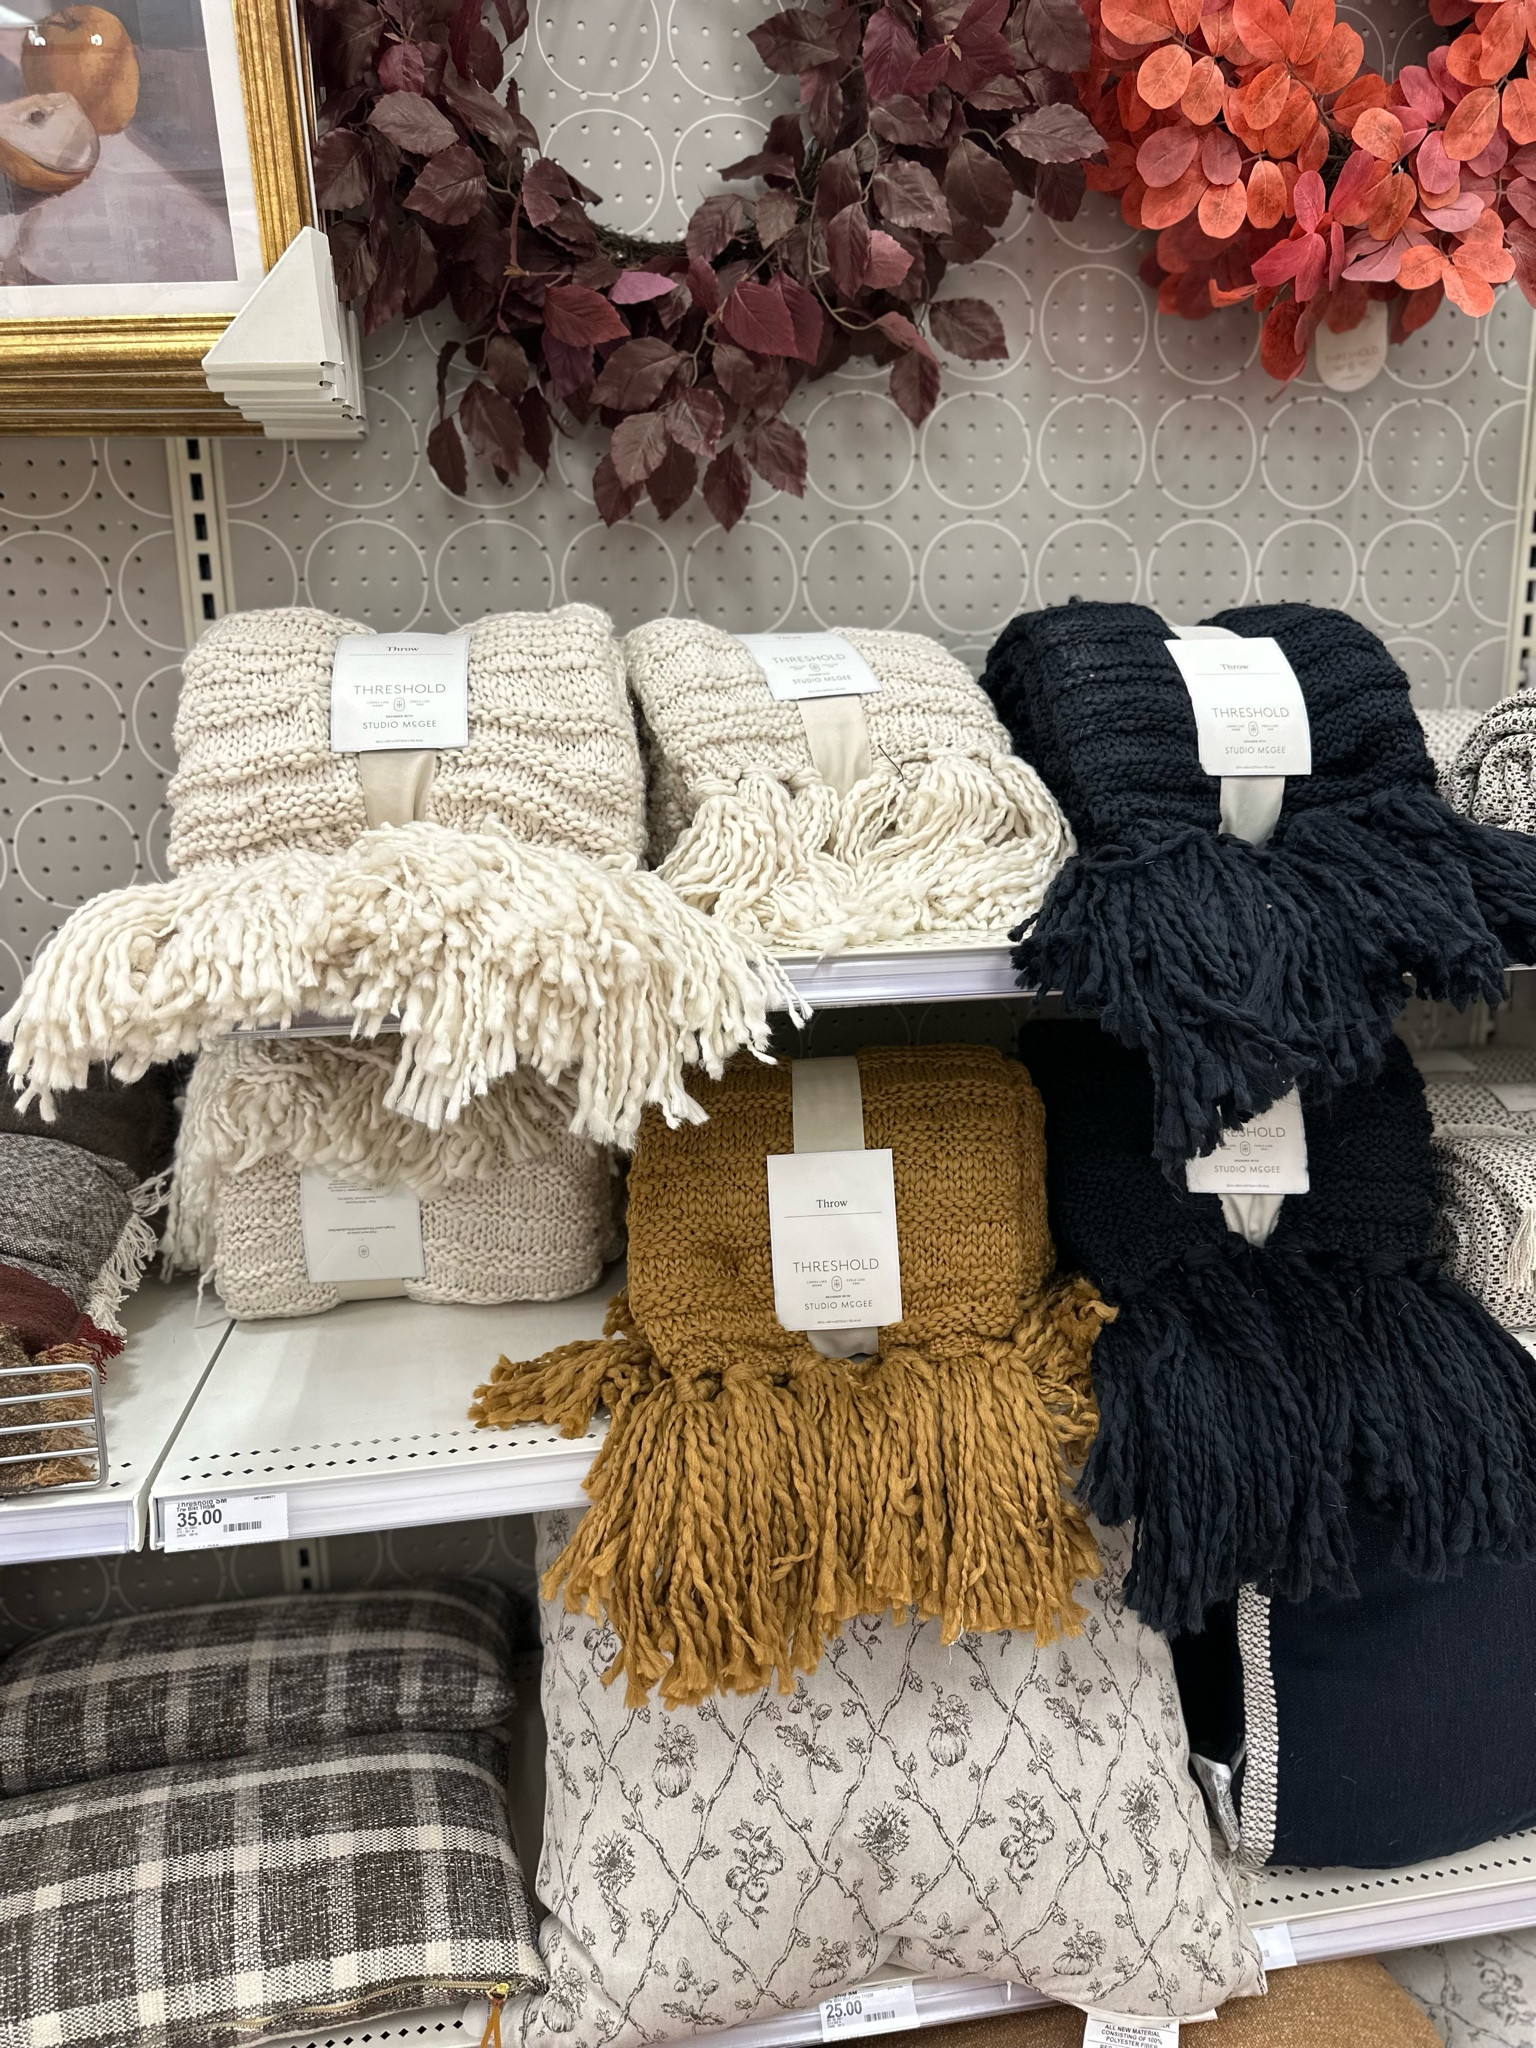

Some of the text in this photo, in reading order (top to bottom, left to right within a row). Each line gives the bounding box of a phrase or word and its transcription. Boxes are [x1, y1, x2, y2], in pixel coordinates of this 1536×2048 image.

[772, 653, 846, 664] THRESHOLD
[354, 683, 446, 695] THRESHOLD
[1212, 707, 1290, 718] THRESHOLD
[362, 720, 399, 730] STUDIO
[1225, 746, 1255, 754] STUDIO
[1222, 1127, 1286, 1138] RESHOLD
[1214, 1165, 1246, 1173] STUDIO
[816, 1199, 848, 1208] Throw
[793, 1258, 879, 1273] THRESHOLD
[804, 1301, 838, 1310] STUDIO
[177, 1509, 222, 1528] 35.00
[826, 2000, 862, 2019] 25.00
[1101, 2029, 1137, 2040] CONSISTING
[1148, 2037, 1163, 2045] 100%
[1132, 2028, 1160, 2037] MATERIAL
[1106, 2036, 1140, 2047] POLYESTER
